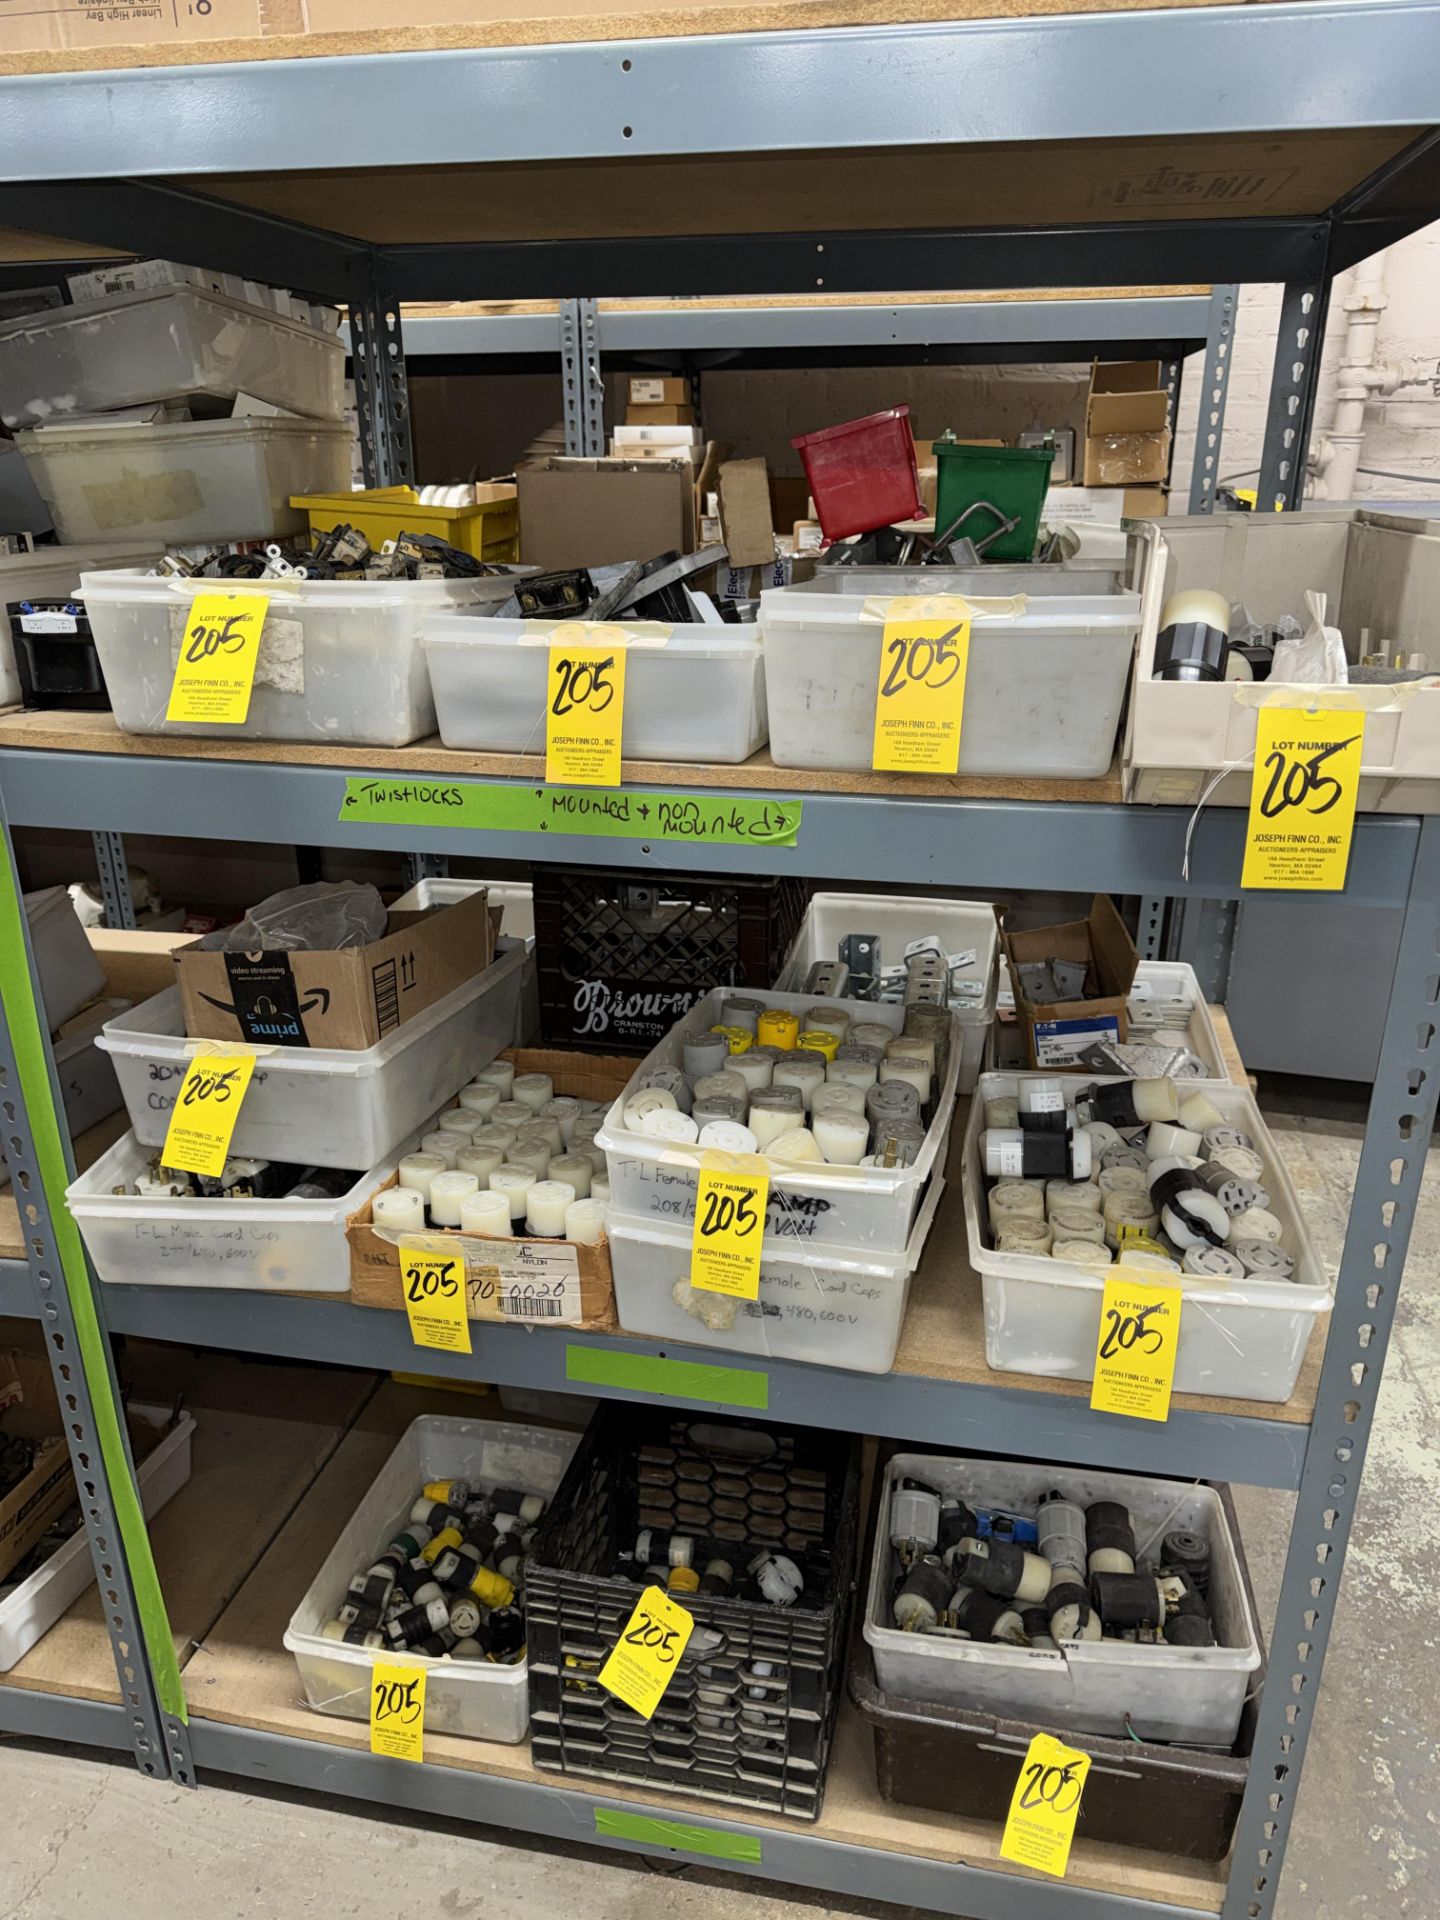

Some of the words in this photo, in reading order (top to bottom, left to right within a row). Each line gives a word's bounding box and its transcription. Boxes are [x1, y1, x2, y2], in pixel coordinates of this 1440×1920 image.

[85, 10, 104, 22] Bay
[106, 8, 129, 21] High
[132, 8, 162, 19] Linear
[186, 612, 250, 663] 205
[881, 622, 963, 697] 205
[233, 680, 246, 688] INC.
[552, 655, 615, 716] 205
[881, 719, 907, 728] JOSEPH
[908, 720, 925, 729] FINN
[941, 721, 956, 730] INC.
[552, 736, 575, 745] JOSEPH
[575, 737, 590, 745] FINN
[604, 738, 616, 747] INC.
[1272, 741, 1295, 751] LOT
[1297, 741, 1347, 751] NUMBR
[1260, 734, 1362, 818] 205
[1253, 833, 1286, 843] JOSEPH
[1287, 834, 1306, 844] FINN
[1327, 835, 1343, 845] INC.
[250, 966, 285, 975] streaming
[250, 1021, 299, 1039] prime
[614, 1019, 664, 1030] CRANSTON
[197, 1068, 211, 1076] LOT
[212, 1070, 242, 1082] NUER
[183, 1067, 241, 1106] 205
[708, 1181, 724, 1189] LOT
[700, 1190, 758, 1237] 205
[696, 1247, 717, 1256] JOSEPH
[718, 1250, 732, 1259] FINN
[744, 1256, 755, 1264] INC.
[406, 1261, 459, 1303] 205
[758, 1273, 806, 1291] emale
[1114, 1299, 1131, 1309] LOT
[1100, 1301, 1166, 1359] 205
[1100, 1368, 1124, 1378] JOSEPH
[1125, 1371, 1139, 1381] FINN
[1154, 1378, 1167, 1386] INC.
[625, 1612, 681, 1663] 205
[375, 1678, 422, 1724] 205
[1020, 1760, 1084, 1813] 205
